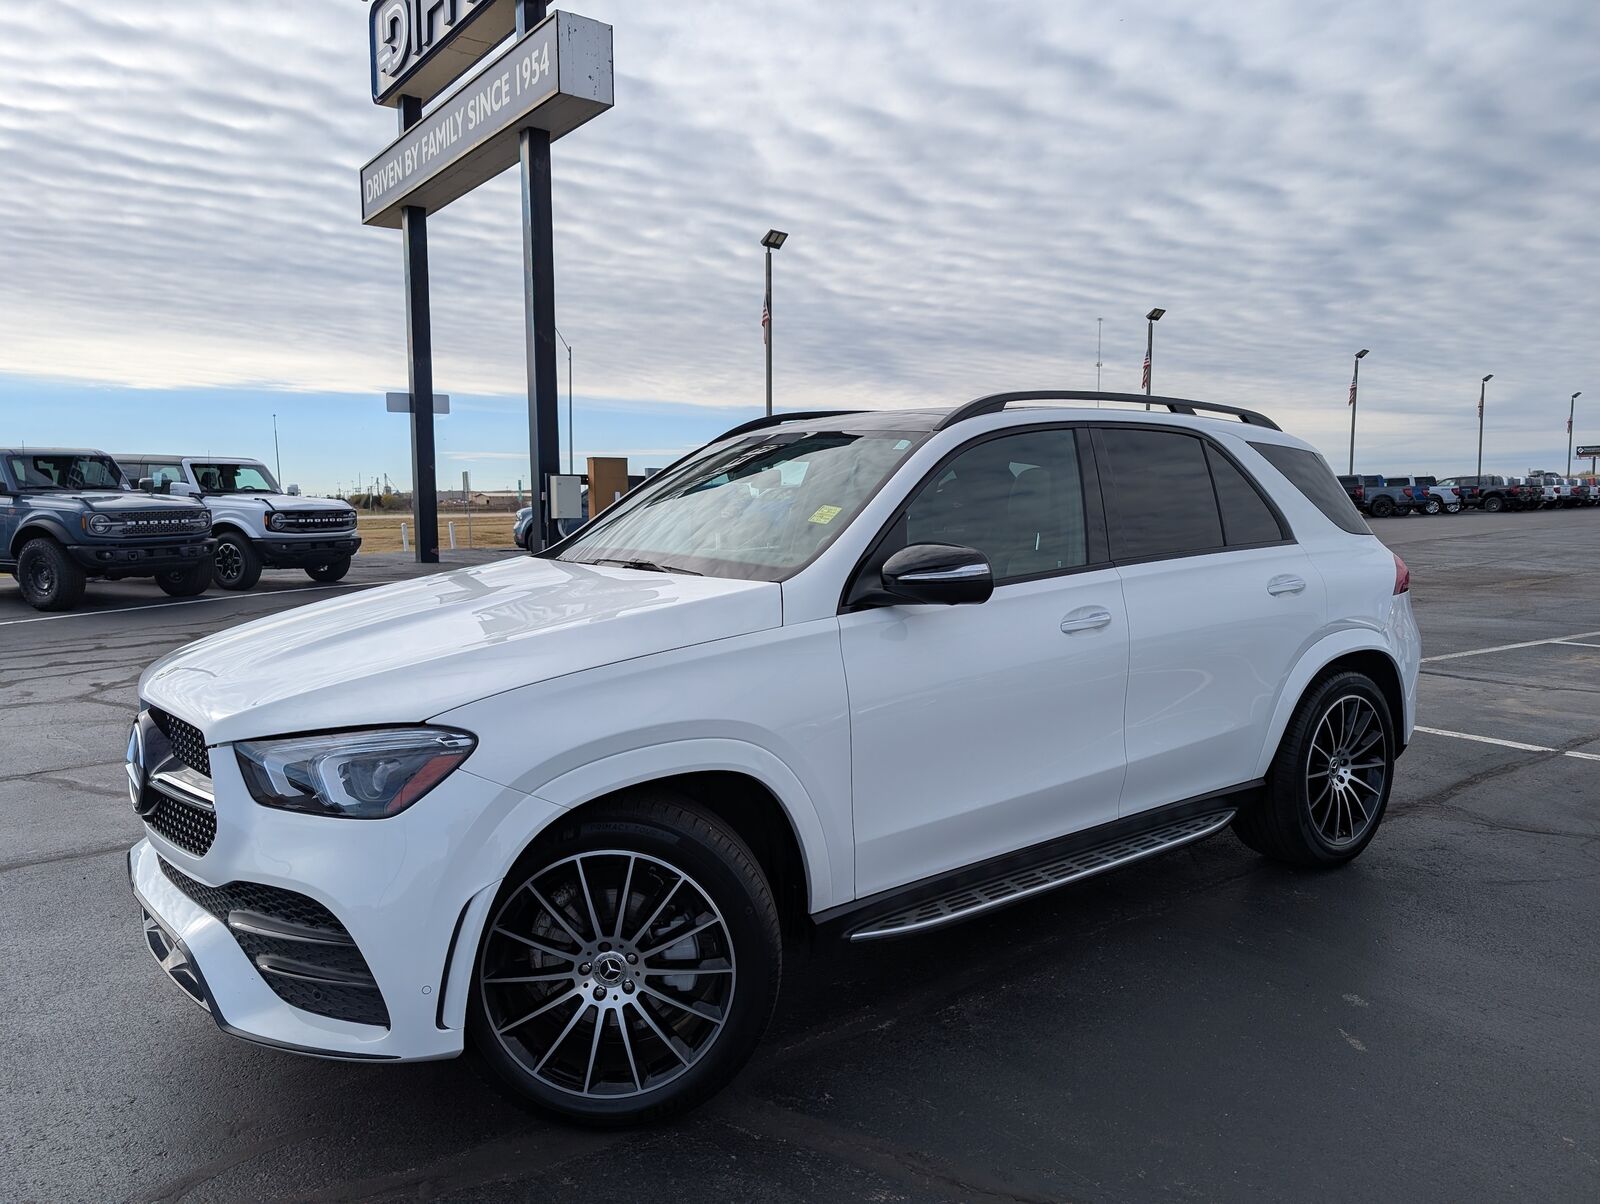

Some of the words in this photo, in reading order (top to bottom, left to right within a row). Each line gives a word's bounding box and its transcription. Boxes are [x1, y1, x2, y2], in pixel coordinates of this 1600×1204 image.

[365, 156, 403, 204] DRIVEN
[404, 141, 421, 177] BY
[421, 106, 465, 165] FAMILY
[467, 72, 511, 130] SINCE
[515, 41, 550, 96] 1954
[126, 518, 189, 526] BRONCO
